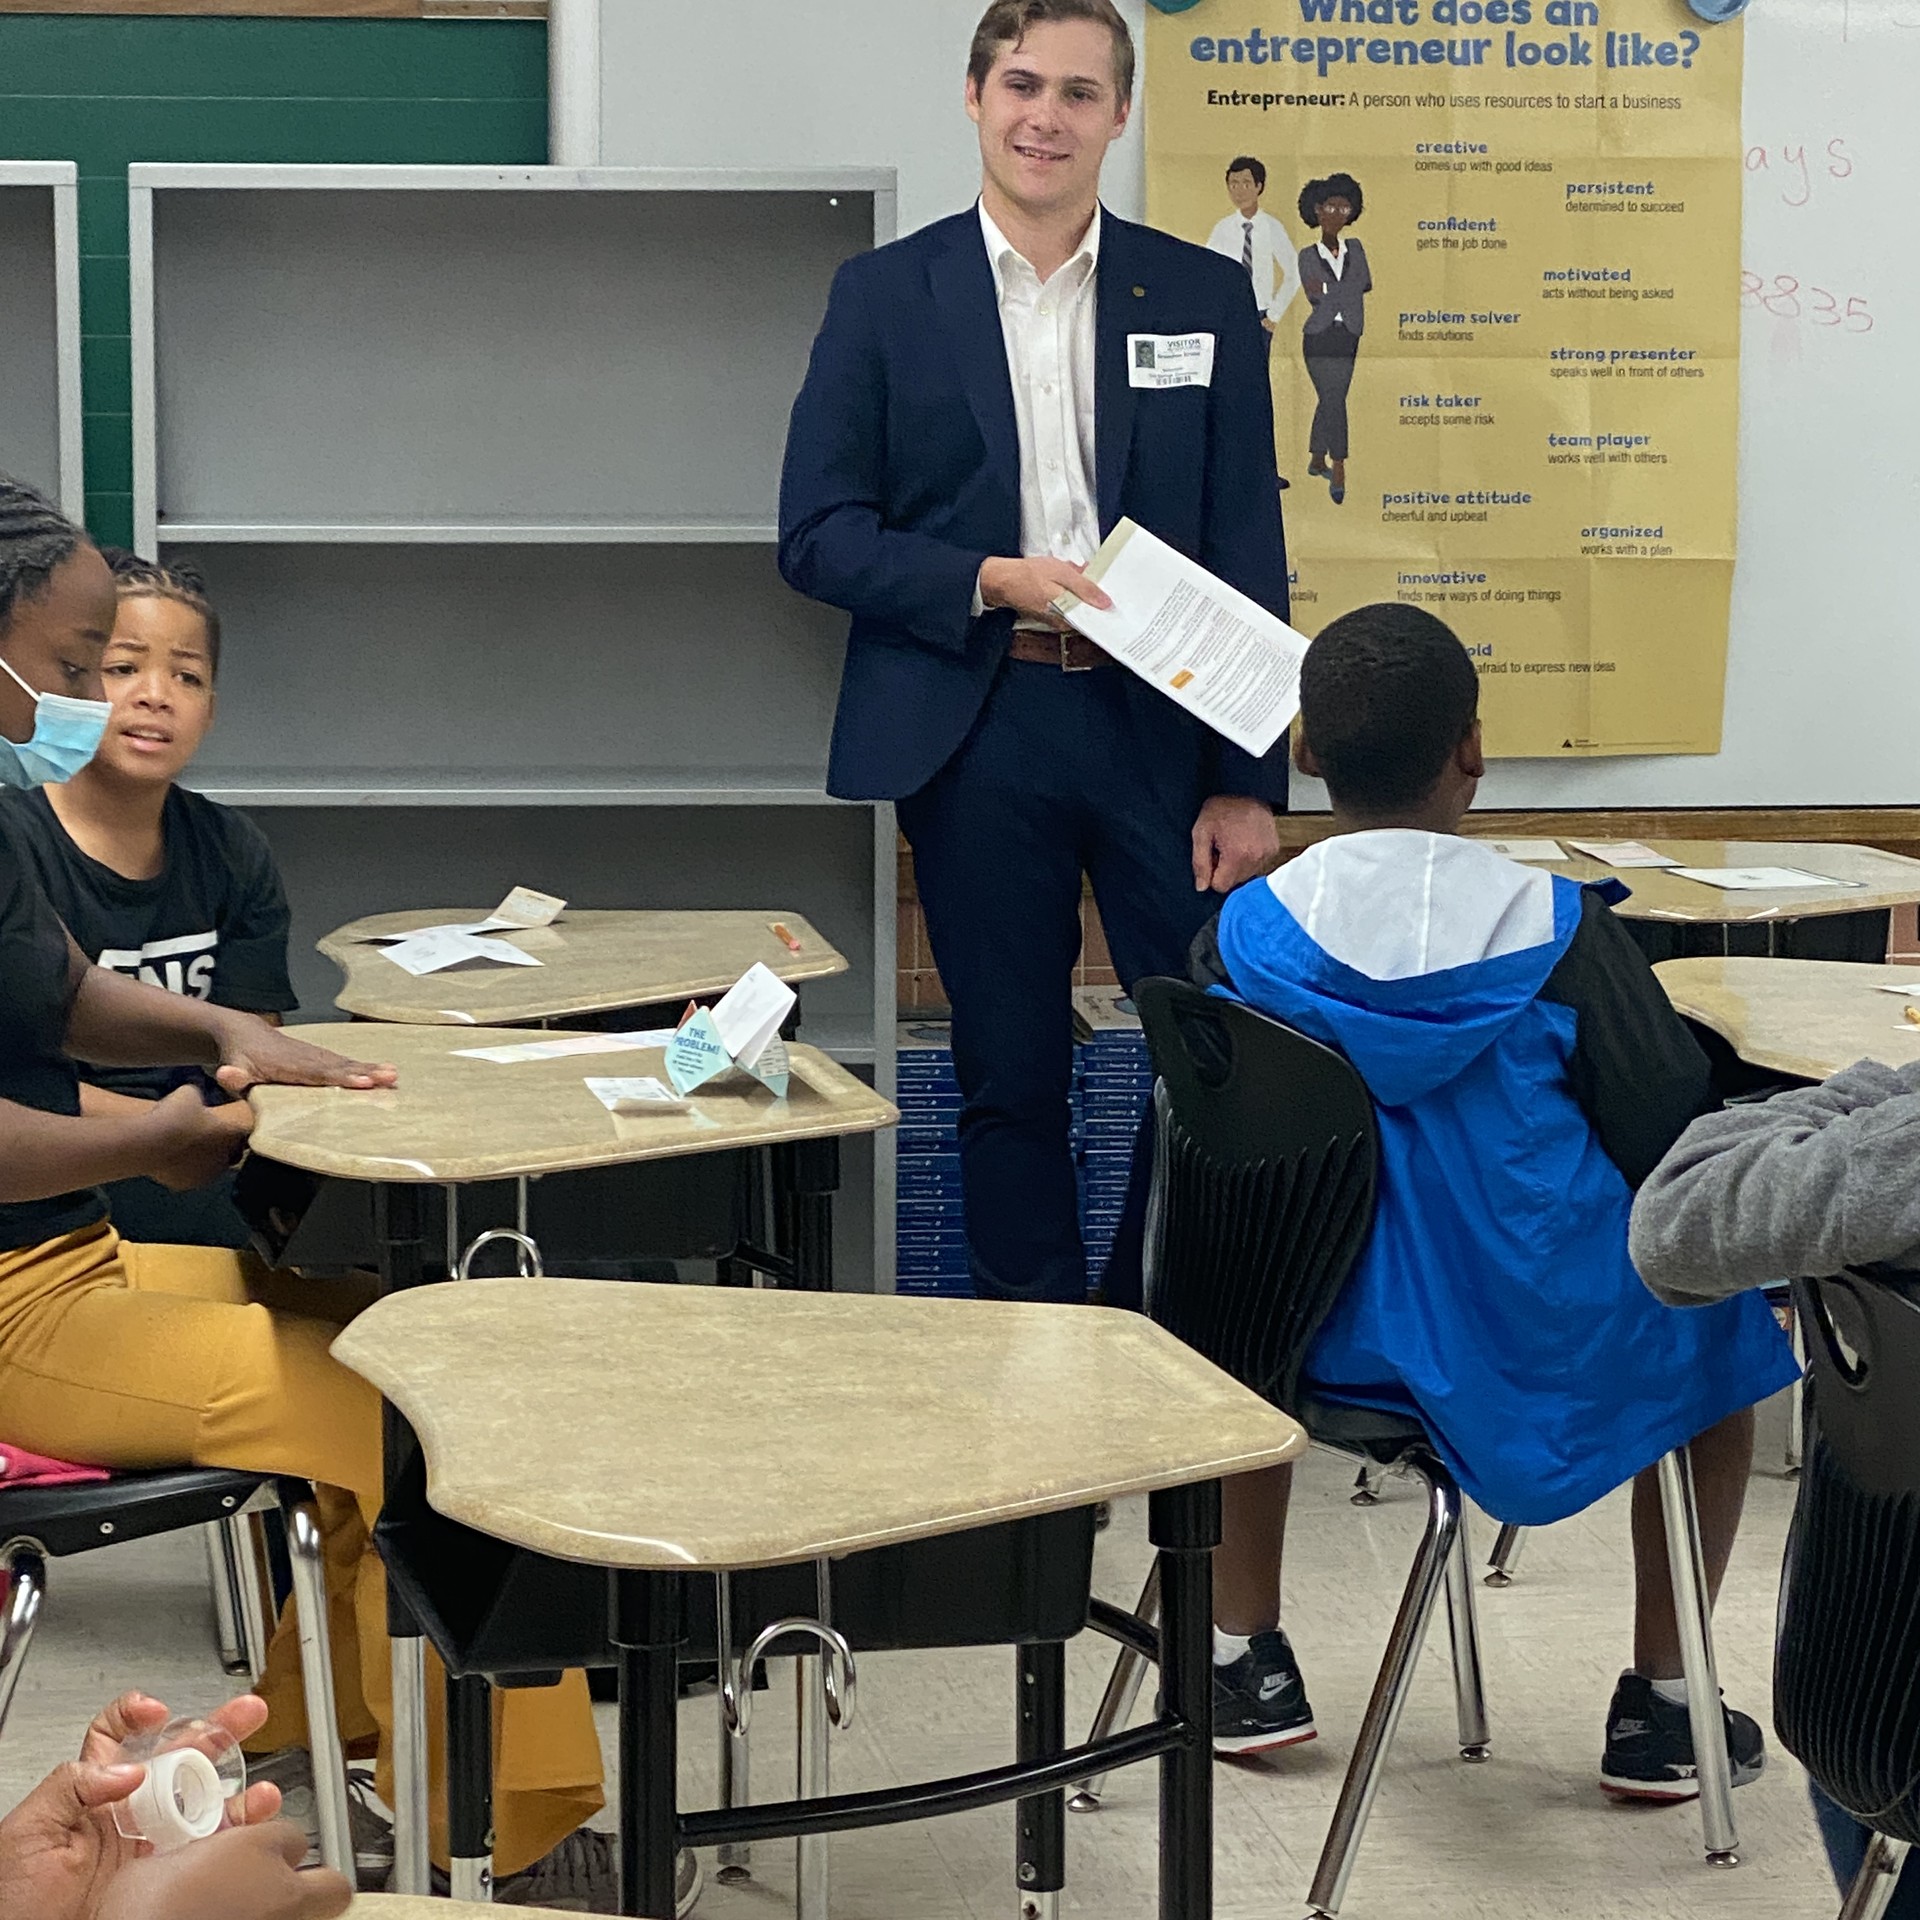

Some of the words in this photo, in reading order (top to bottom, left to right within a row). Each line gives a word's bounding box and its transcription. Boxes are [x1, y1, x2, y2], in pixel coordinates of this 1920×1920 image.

[1432, 0, 1532, 25] does
[1545, 0, 1599, 26] an
[1190, 27, 1492, 78] entrepreneur
[1505, 30, 1593, 68] look
[1605, 29, 1700, 69] like?
[1207, 89, 1345, 111] Entrepreneur:
[1349, 92, 1360, 106] A
[1363, 93, 1410, 109] person
[1416, 92, 1445, 107] who
[1450, 95, 1480, 108] uses
[1484, 95, 1552, 109] resources
[1557, 94, 1570, 109] to
[1574, 94, 1605, 109] start
[1609, 96, 1618, 108] a
[1622, 93, 1682, 110] business
[1416, 141, 1488, 154] creative
[1415, 159, 1450, 172] comes
[1453, 160, 1467, 174] up
[1470, 158, 1492, 172] with
[1495, 159, 1521, 174] good
[1525, 159, 1552, 172] ideas
[1566, 180, 1655, 199] persistent
[1565, 200, 1624, 213] determined
[1627, 200, 1638, 213] to
[1641, 200, 1685, 213] succeed
[1417, 216, 1497, 232] confident
[1416, 237, 1439, 251] gets
[1442, 236, 1459, 249] the
[1462, 236, 1478, 251] job
[1481, 236, 1507, 250] done
[1543, 268, 1631, 282] motivated
[1542, 287, 1565, 299] acts
[1567, 286, 1606, 299] without
[1609, 286, 1638, 301] being
[1642, 287, 1674, 299] asked
[1399, 310, 1465, 328] problem
[1470, 310, 1521, 324] solver
[1167, 338, 1201, 348] VISITOR
[1426, 329, 1474, 342] solutions
[1550, 347, 1606, 363] strong
[1610, 348, 1697, 364] presenter
[1550, 365, 1588, 379] speaks
[1590, 365, 1613, 378] well
[1616, 365, 1625, 378] in
[1629, 365, 1654, 378] front
[1657, 365, 1668, 378] of
[1670, 366, 1704, 379] others
[1399, 394, 1430, 408] risk
[1435, 394, 1482, 408] taker
[1399, 414, 1440, 427] accepts
[1443, 415, 1472, 426] some
[1474, 413, 1495, 426] risk
[1548, 433, 1592, 447] team
[1596, 432, 1651, 450] player
[1548, 452, 1581, 465] works
[1584, 452, 1606, 464] well
[1608, 452, 1632, 464] with
[1634, 452, 1668, 464] others
[1382, 490, 1450, 508] positive
[1455, 490, 1532, 504] attitude
[1382, 510, 1425, 523] cheerful
[1427, 510, 1447, 523] and
[1450, 510, 1488, 525] upbeat
[1581, 525, 1664, 539] organized
[1581, 544, 1613, 556] works
[1615, 543, 1638, 556] with
[1640, 545, 1648, 556] a
[1651, 543, 1673, 557] plan
[1397, 570, 1487, 584] innovative
[1425, 591, 1446, 602] new
[1449, 591, 1478, 604] ways
[1480, 589, 1492, 601] of
[1494, 588, 1525, 604] doing
[1527, 588, 1562, 604] things
[1477, 660, 1507, 674] afraid
[1510, 660, 1521, 673] to
[1524, 660, 1565, 675] express
[1568, 662, 1592, 673] new
[688, 1027, 707, 1040] THE
